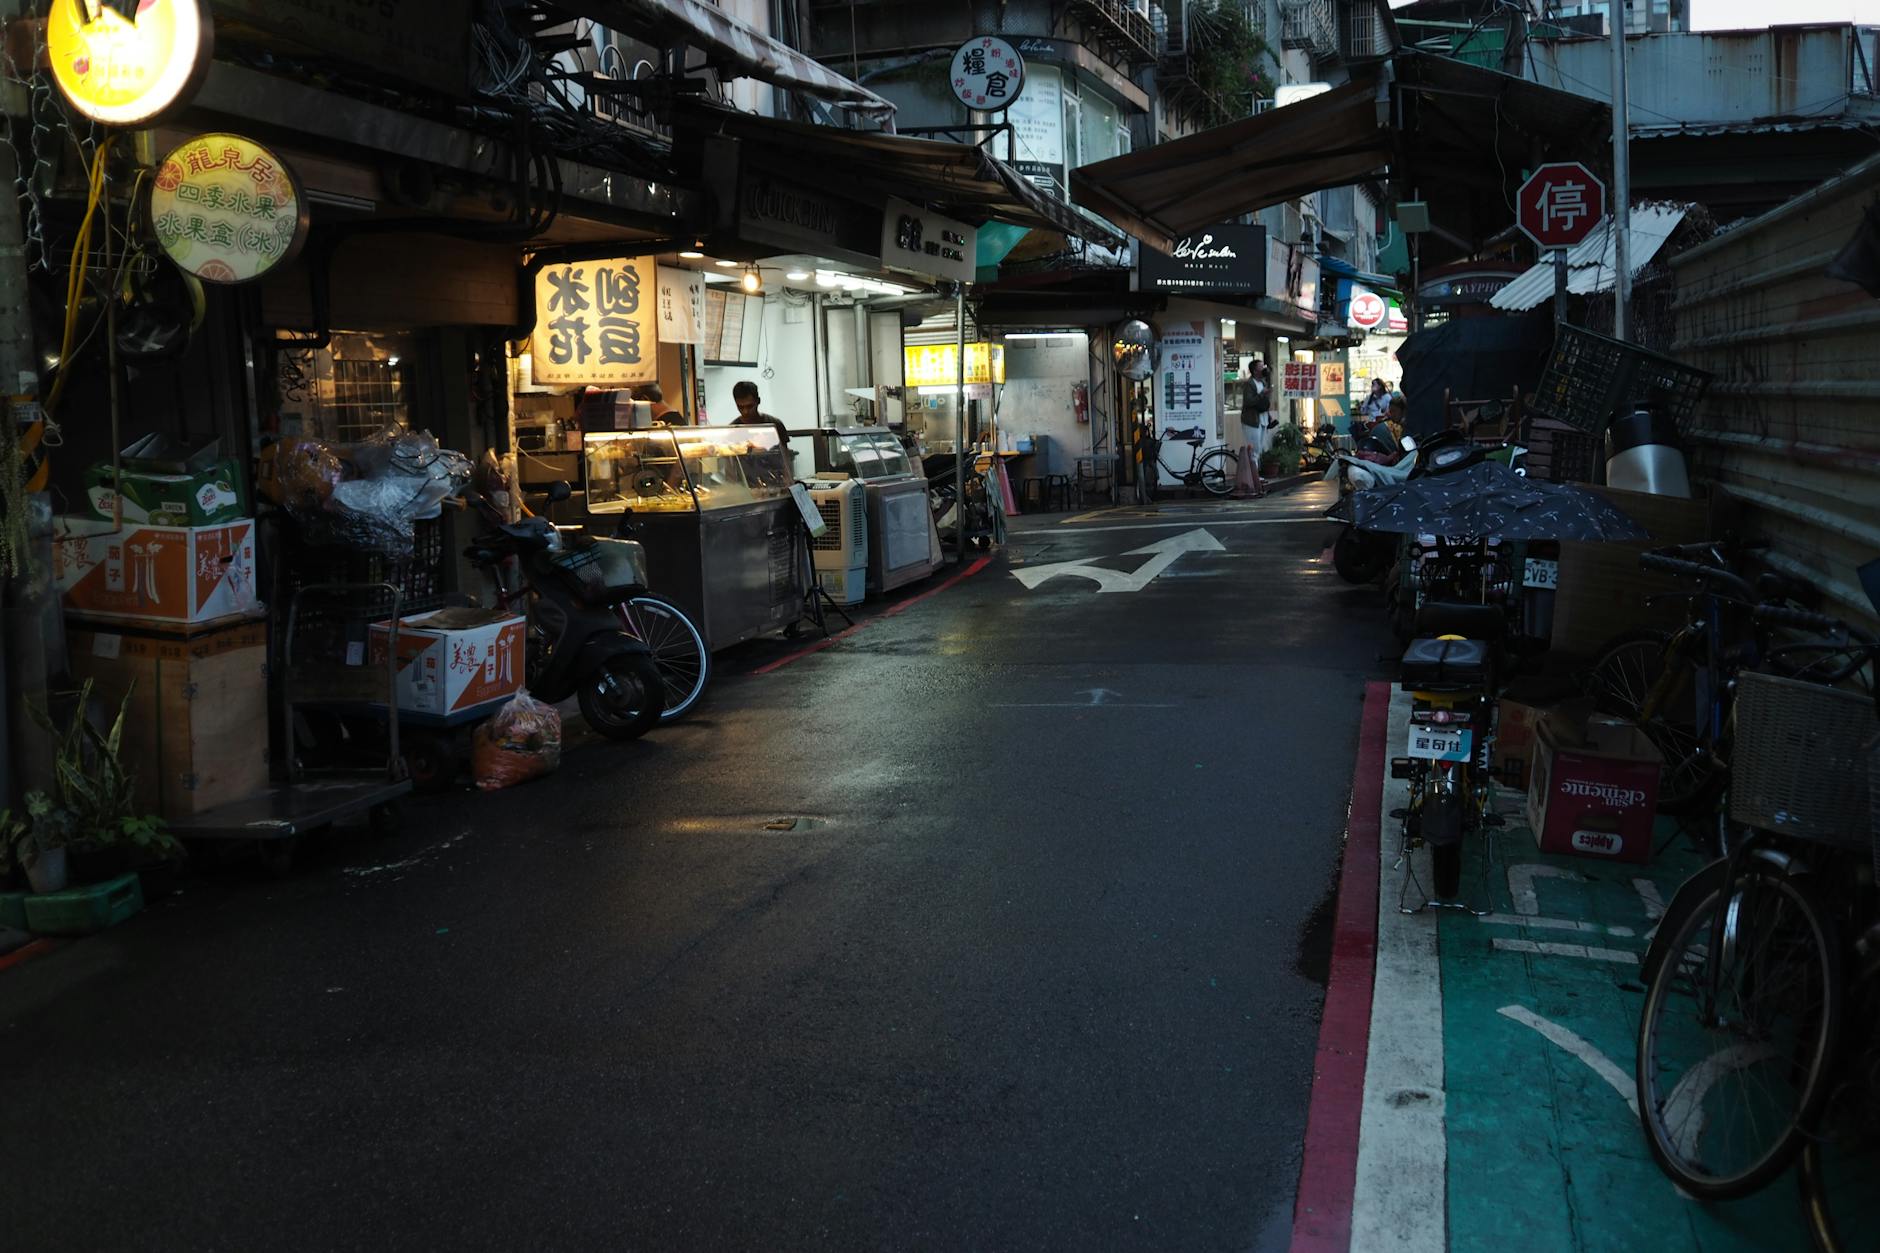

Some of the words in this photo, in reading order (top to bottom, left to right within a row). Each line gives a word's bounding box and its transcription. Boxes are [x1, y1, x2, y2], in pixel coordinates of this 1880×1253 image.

[963, 48, 1009, 97] 糧倉
[186, 147, 273, 183] 龍泉居
[178, 183, 276, 220] 四季水果
[1536, 180, 1587, 232] 停
[1455, 281, 1511, 295] AYPHO
[1284, 363, 1317, 377] 影印
[1284, 377, 1316, 391] 裝訂
[164, 503, 183, 513] GREEN
[1560, 781, 1646, 805] clemente
[1605, 798, 1633, 809] san
[1579, 834, 1615, 850] Apples
